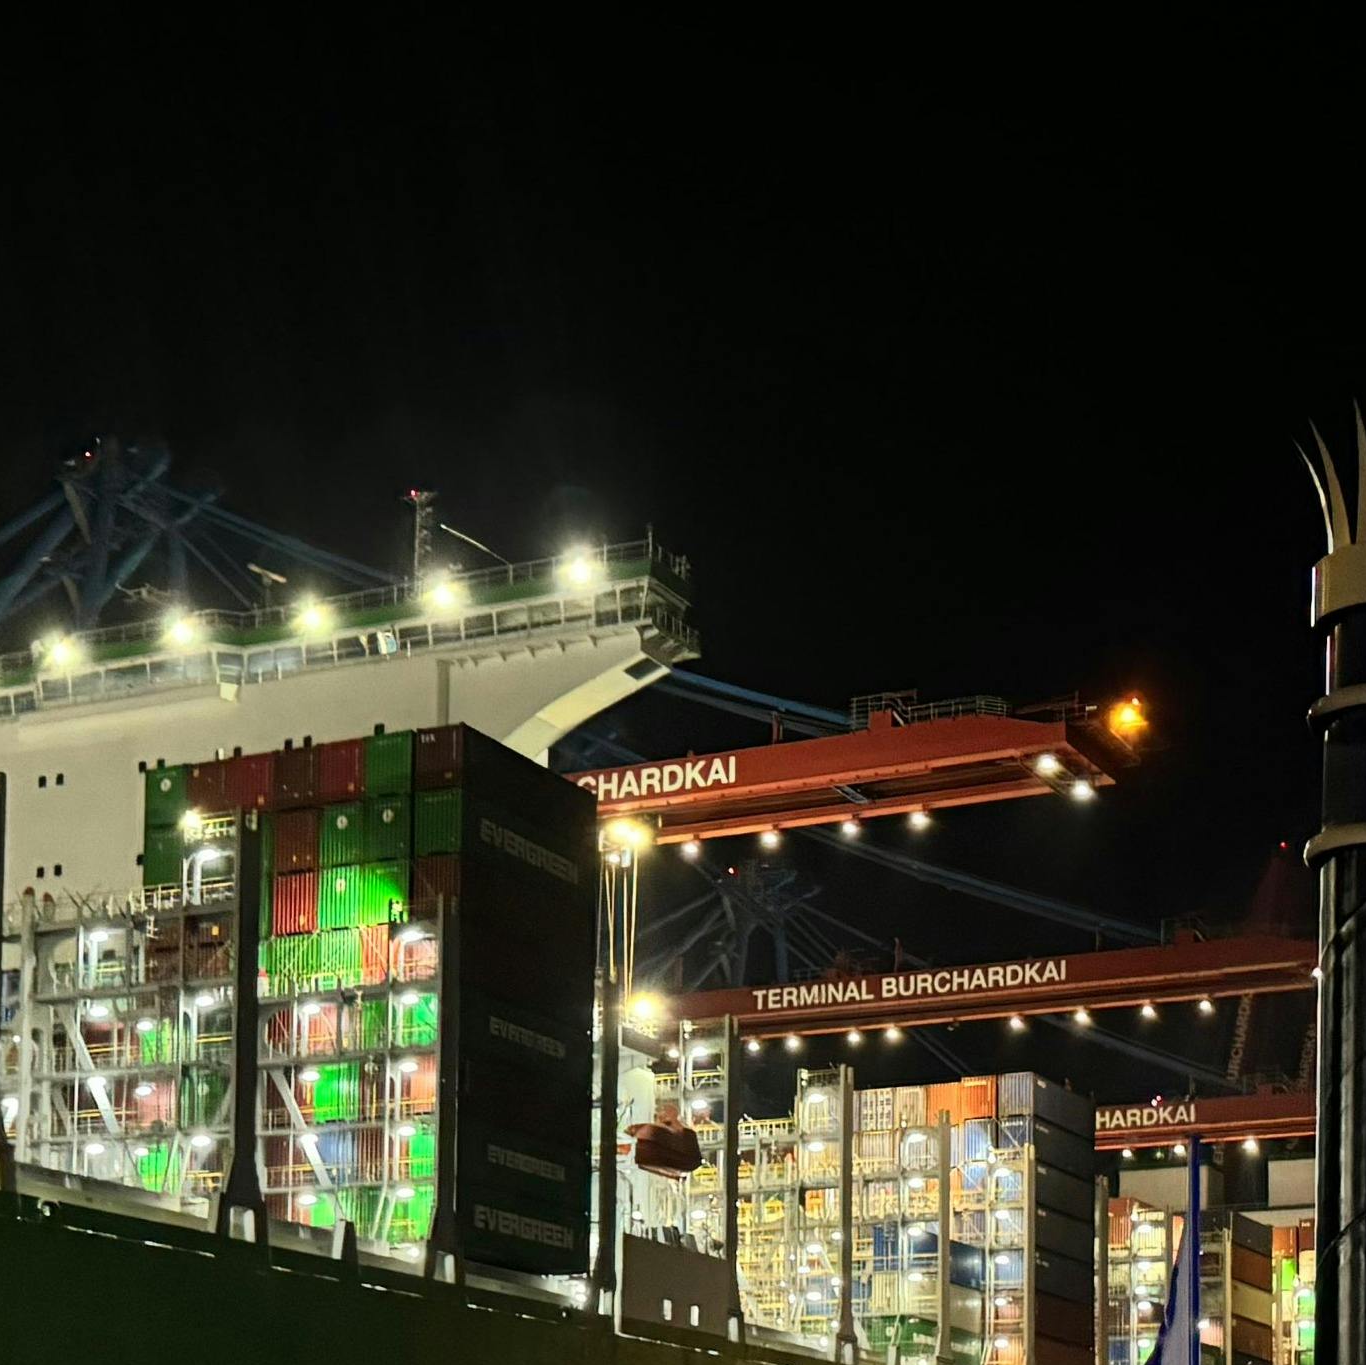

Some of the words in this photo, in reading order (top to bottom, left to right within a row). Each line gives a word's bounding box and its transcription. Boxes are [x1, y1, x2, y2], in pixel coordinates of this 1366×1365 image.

[479, 816, 579, 885] EVERGREEN
[752, 978, 875, 1011] TERMINAL
[881, 959, 1068, 999] BURCHARDKAI
[473, 1203, 574, 1251] EVERGREEN
